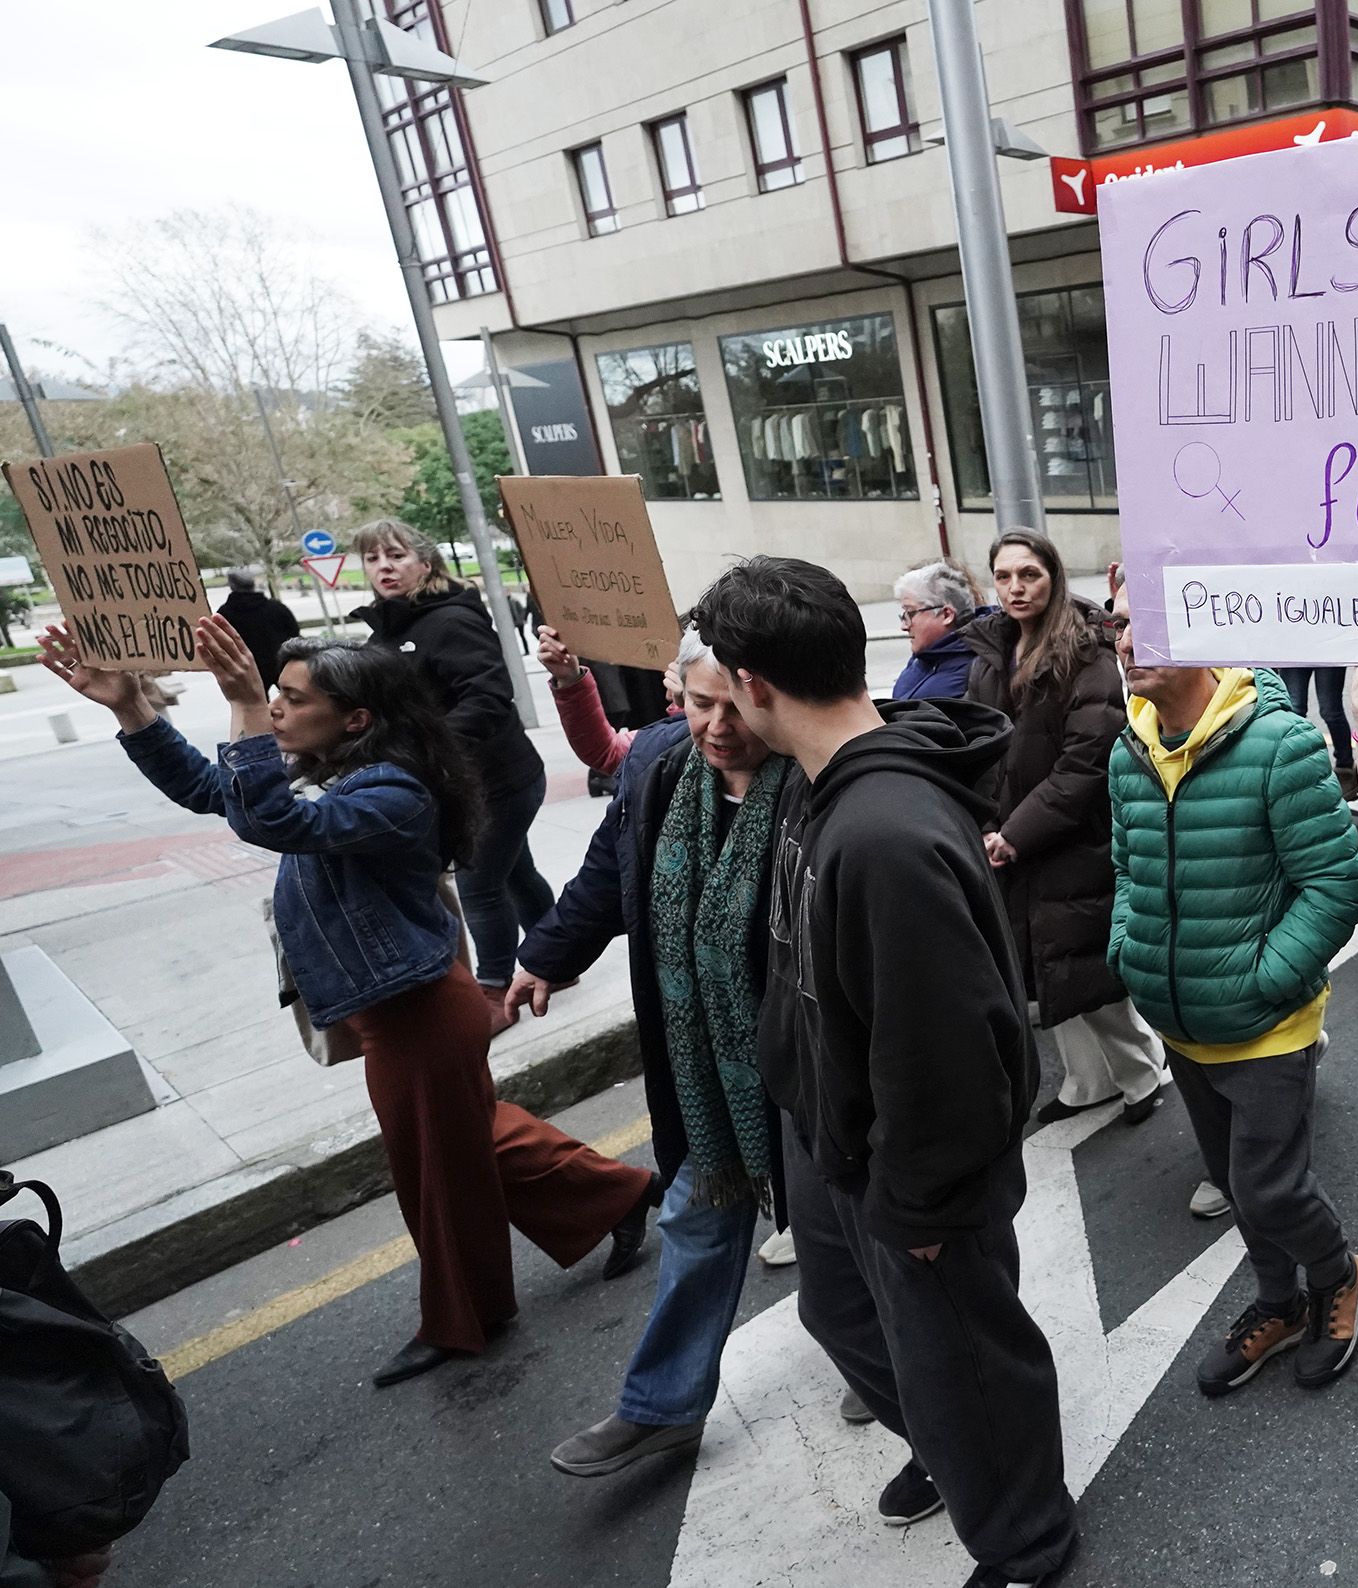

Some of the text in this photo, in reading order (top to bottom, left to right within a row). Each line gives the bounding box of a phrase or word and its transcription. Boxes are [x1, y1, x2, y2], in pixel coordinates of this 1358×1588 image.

[762, 329, 853, 369] SCALPERS
[531, 422, 578, 444] SCALPERS
[56, 463, 94, 512] NO
[89, 459, 125, 512] ES
[55, 505, 85, 557] MI
[579, 507, 635, 556] VIDA,
[62, 560, 197, 604] NO ME TOQUES
[1181, 580, 1263, 629] PERO
[117, 613, 146, 659] EL
